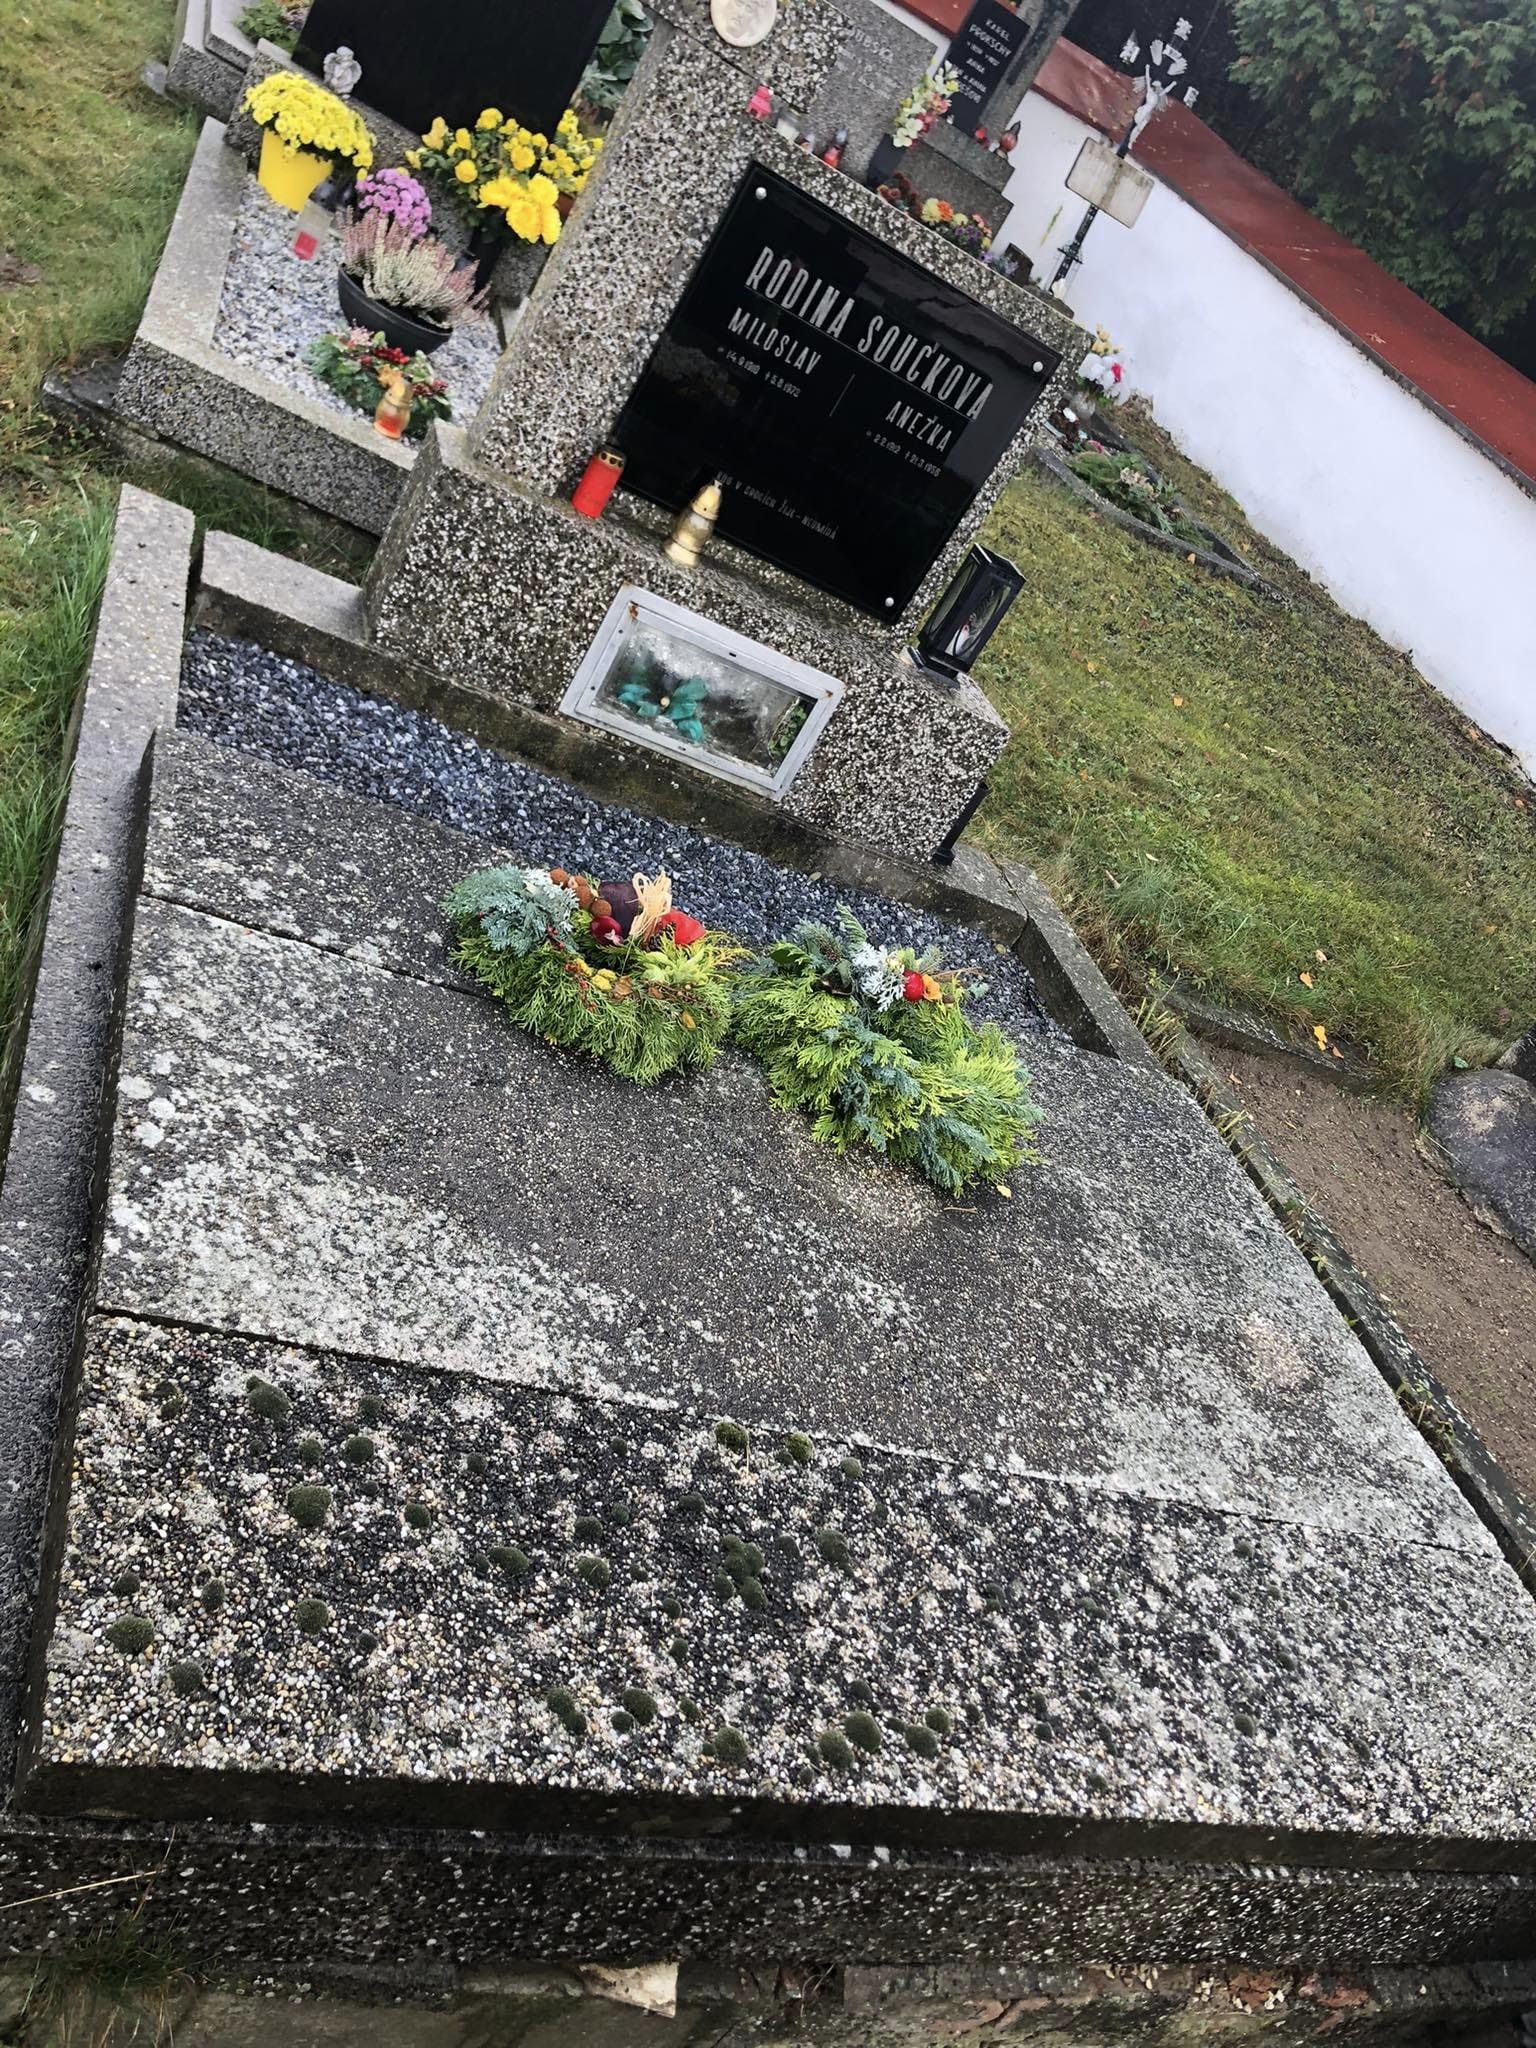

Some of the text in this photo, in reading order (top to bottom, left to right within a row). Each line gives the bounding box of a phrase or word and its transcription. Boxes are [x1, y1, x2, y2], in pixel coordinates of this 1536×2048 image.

[727, 307, 822, 375] MILOSLAV
[745, 246, 994, 421] RODINA SOUČKOVA
[885, 400, 952, 452] ANEŽKA
[735, 481, 742, 490] V
